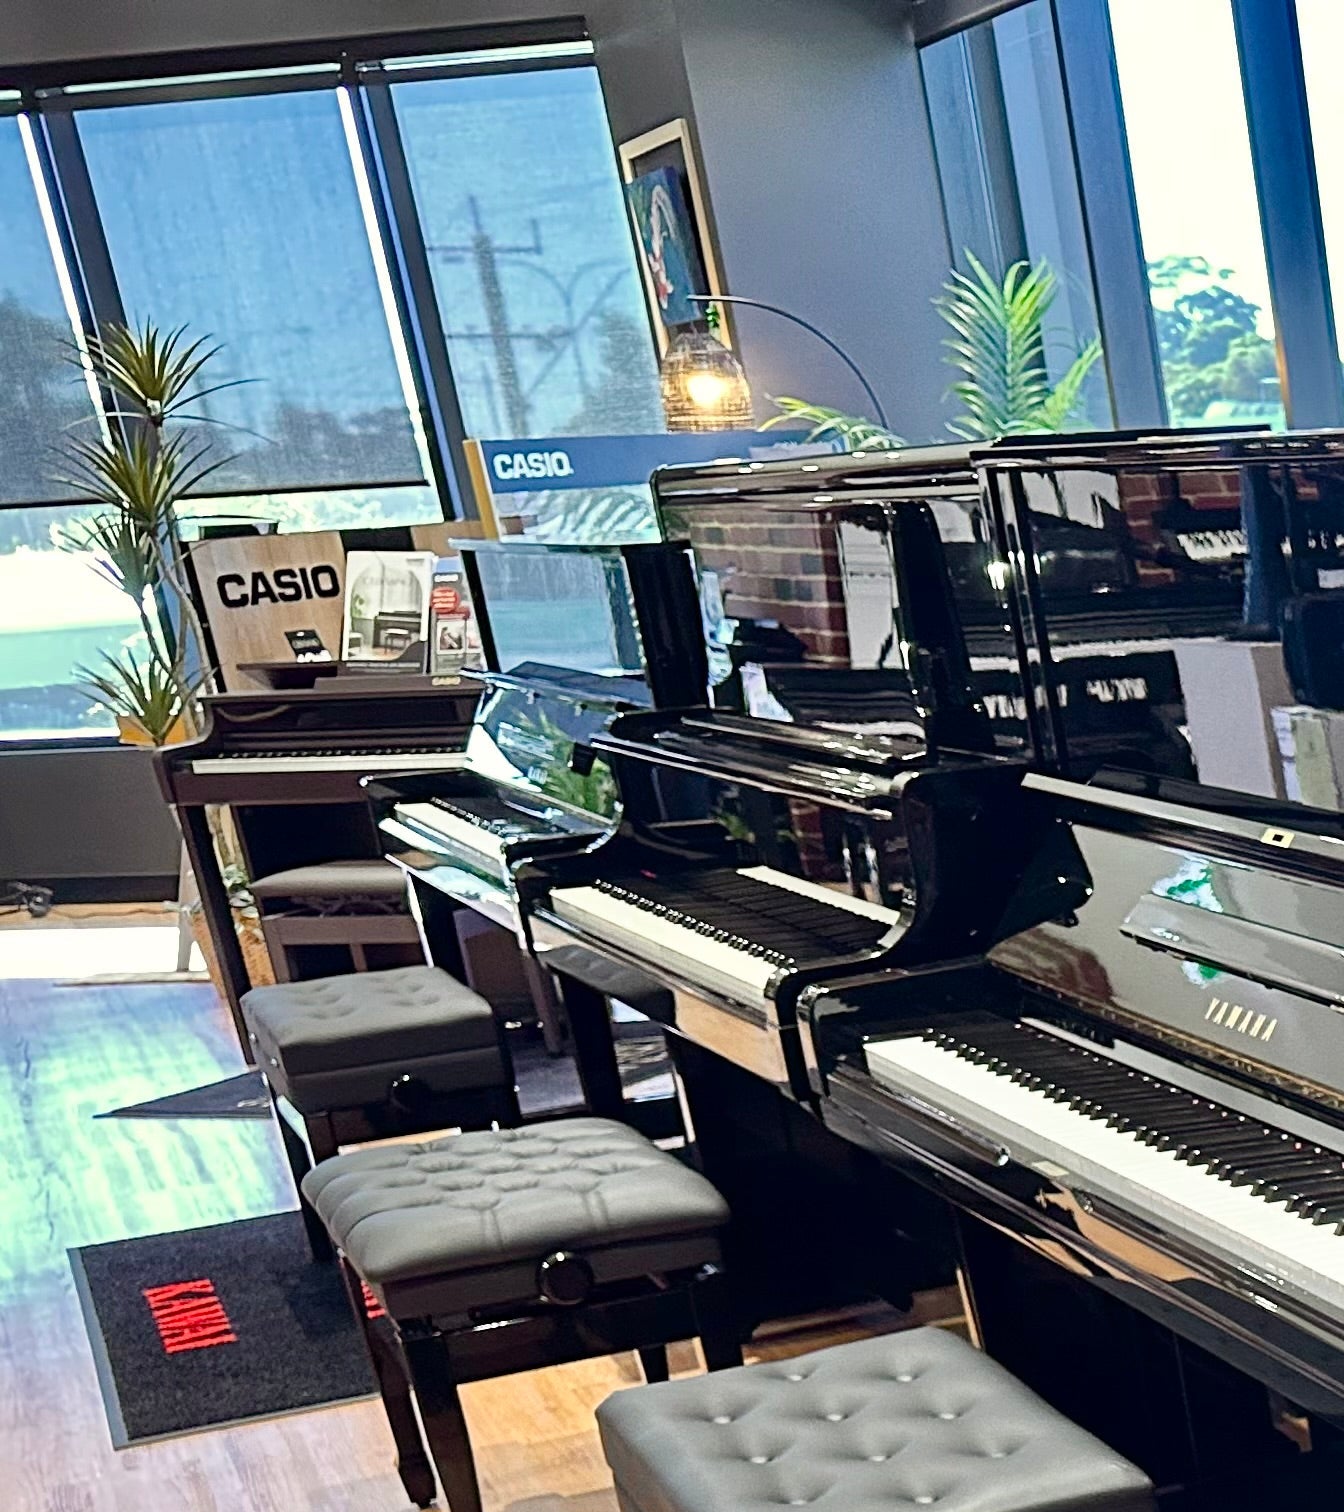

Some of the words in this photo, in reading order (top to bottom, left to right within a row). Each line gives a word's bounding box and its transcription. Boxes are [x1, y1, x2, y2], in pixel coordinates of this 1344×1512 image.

[493, 451, 572, 479] CASIO
[217, 564, 340, 608] CASIO
[1204, 997, 1278, 1042] YAMAHA
